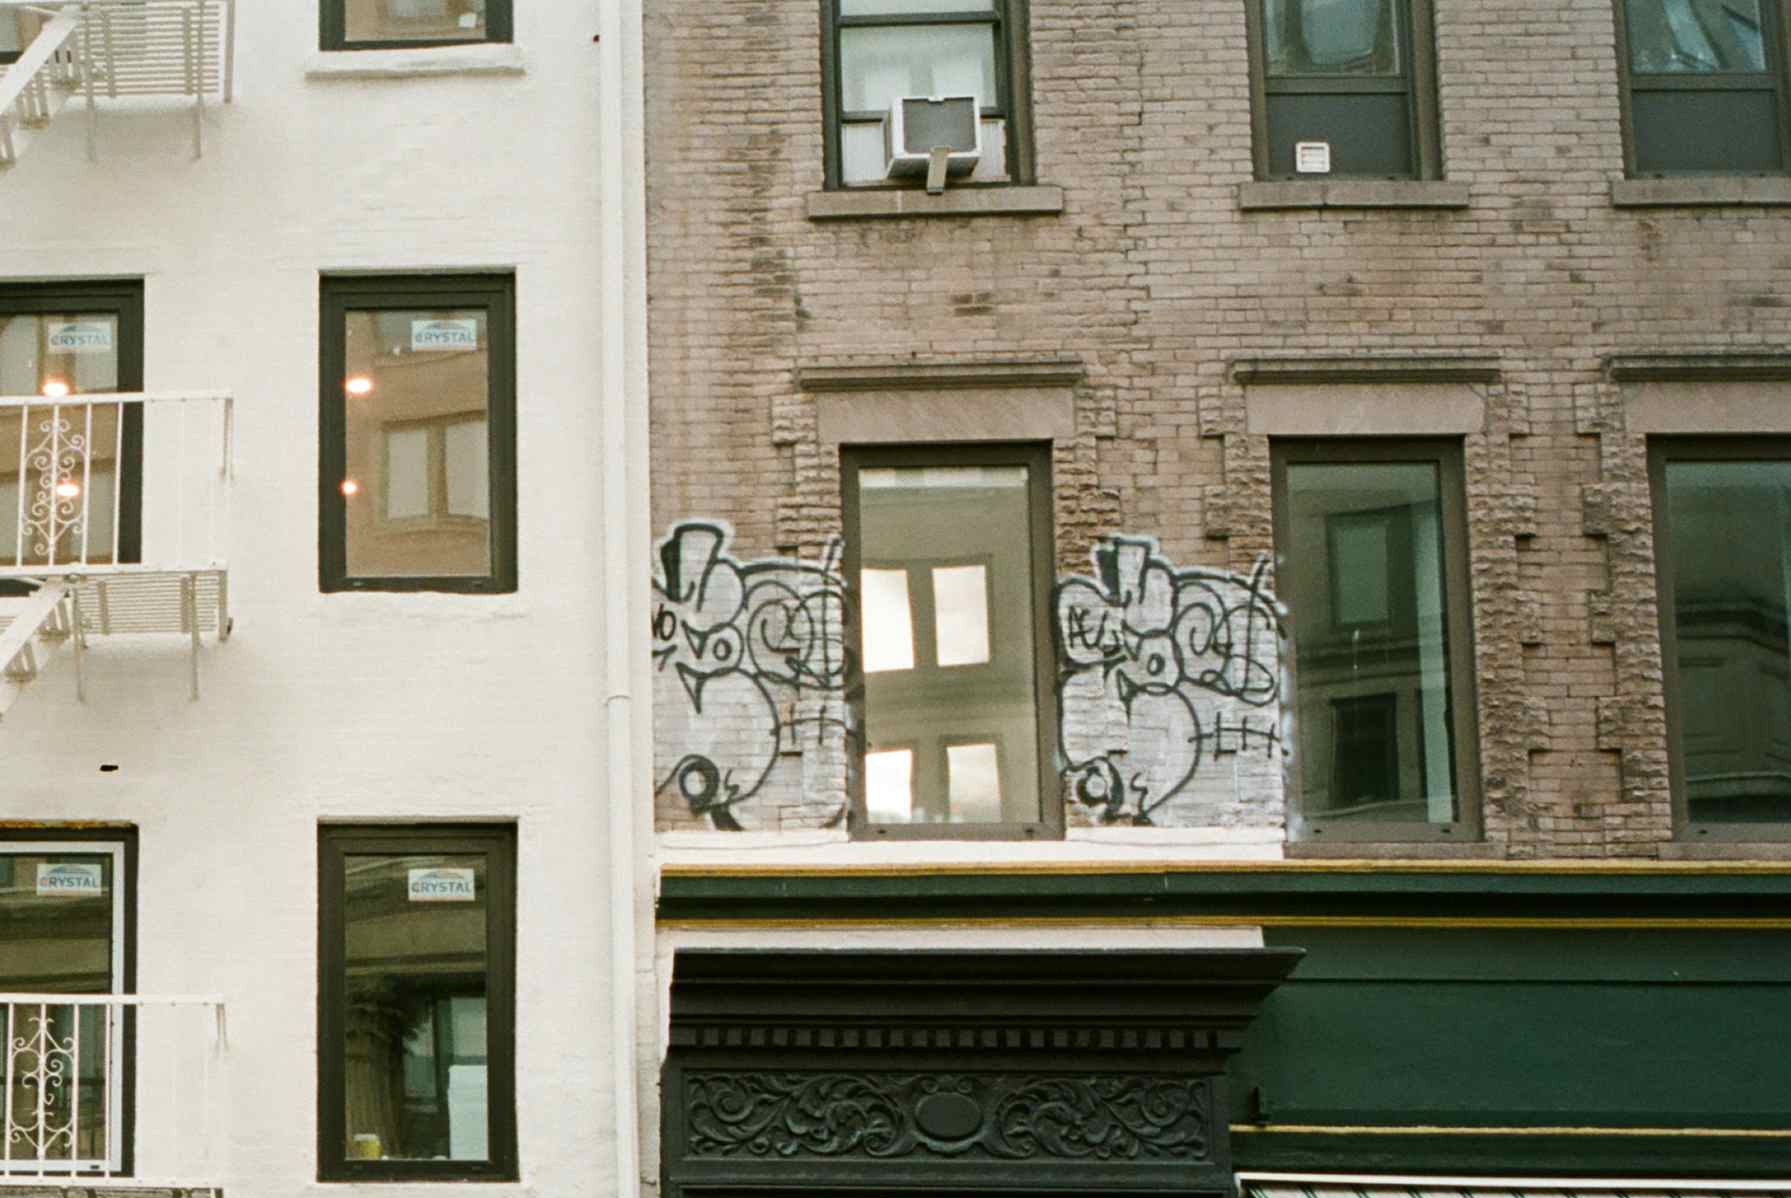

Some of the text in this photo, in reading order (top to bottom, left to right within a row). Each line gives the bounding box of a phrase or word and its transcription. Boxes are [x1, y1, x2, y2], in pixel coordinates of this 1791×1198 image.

[415, 331, 474, 344] CRYSTAL
[39, 876, 98, 889] CRYSTAL
[411, 881, 472, 894] CRYSTAL
